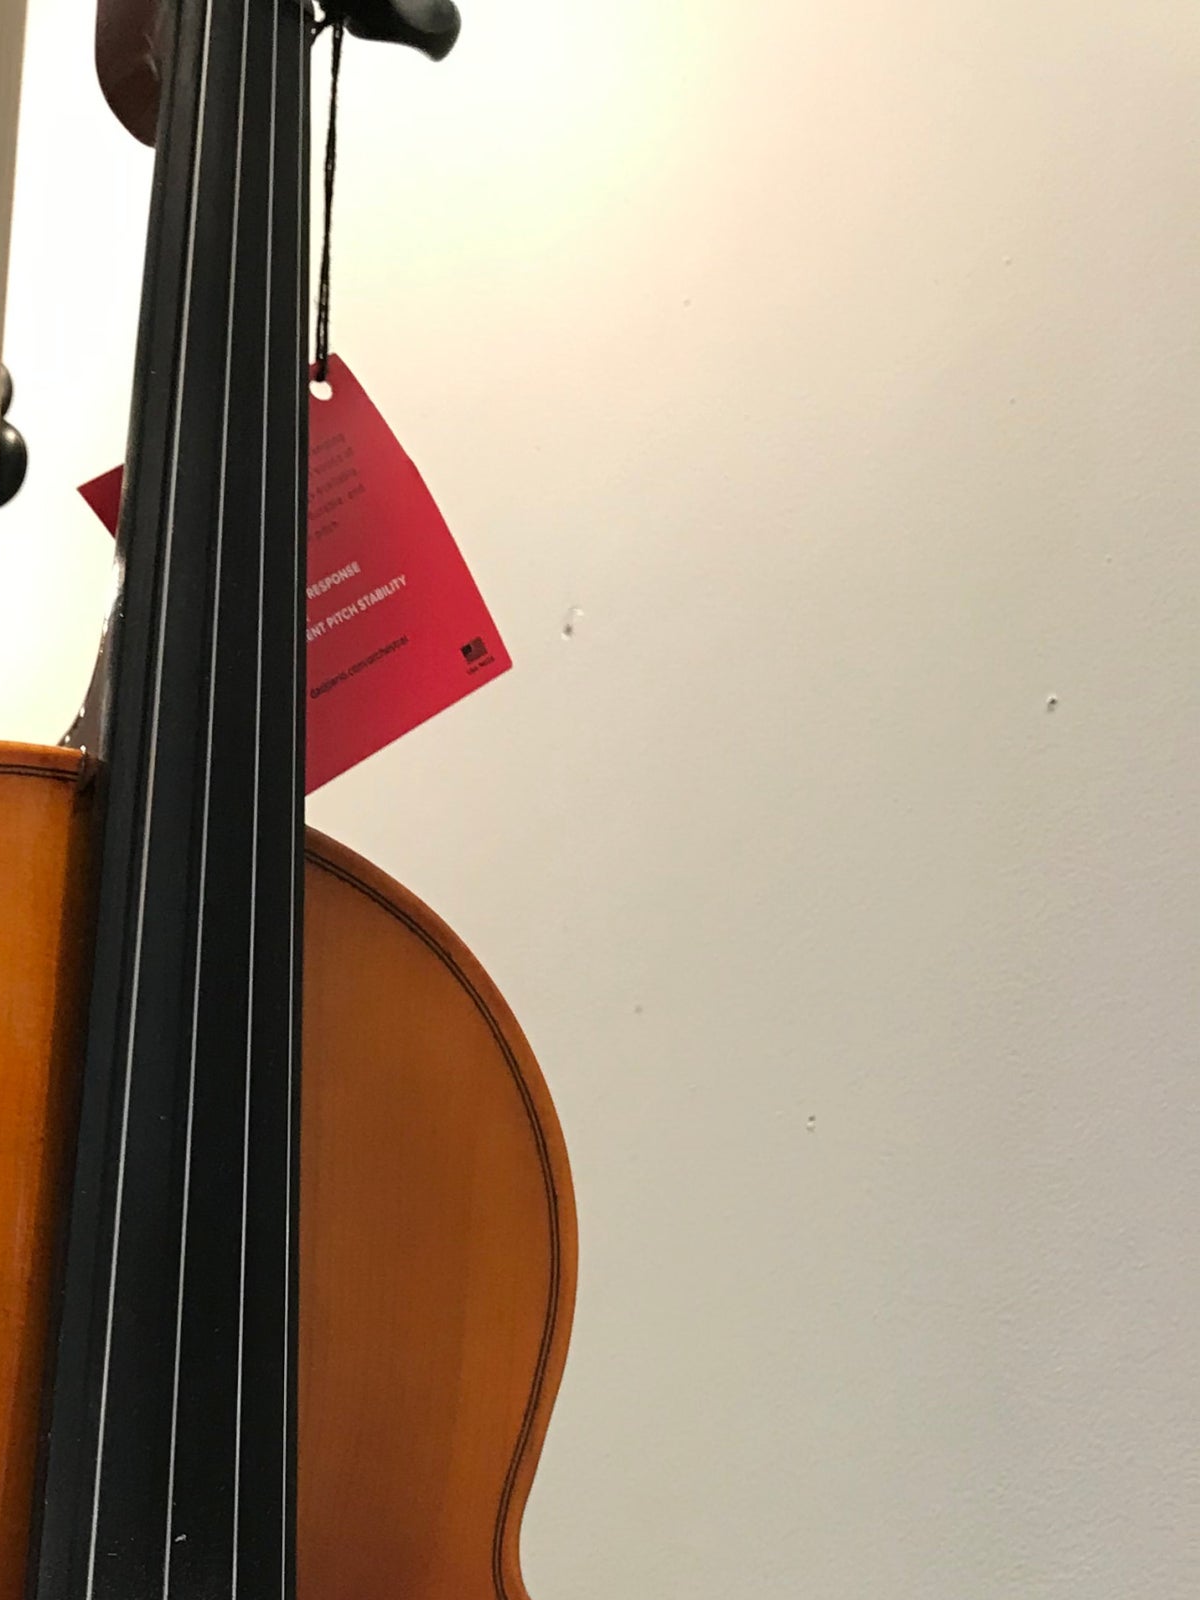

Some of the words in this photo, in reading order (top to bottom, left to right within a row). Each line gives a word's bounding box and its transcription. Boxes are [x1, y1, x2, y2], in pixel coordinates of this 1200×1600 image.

[306, 561, 361, 599] RESPONSE
[326, 603, 359, 629] PITCH
[357, 574, 407, 611] STABILITY
